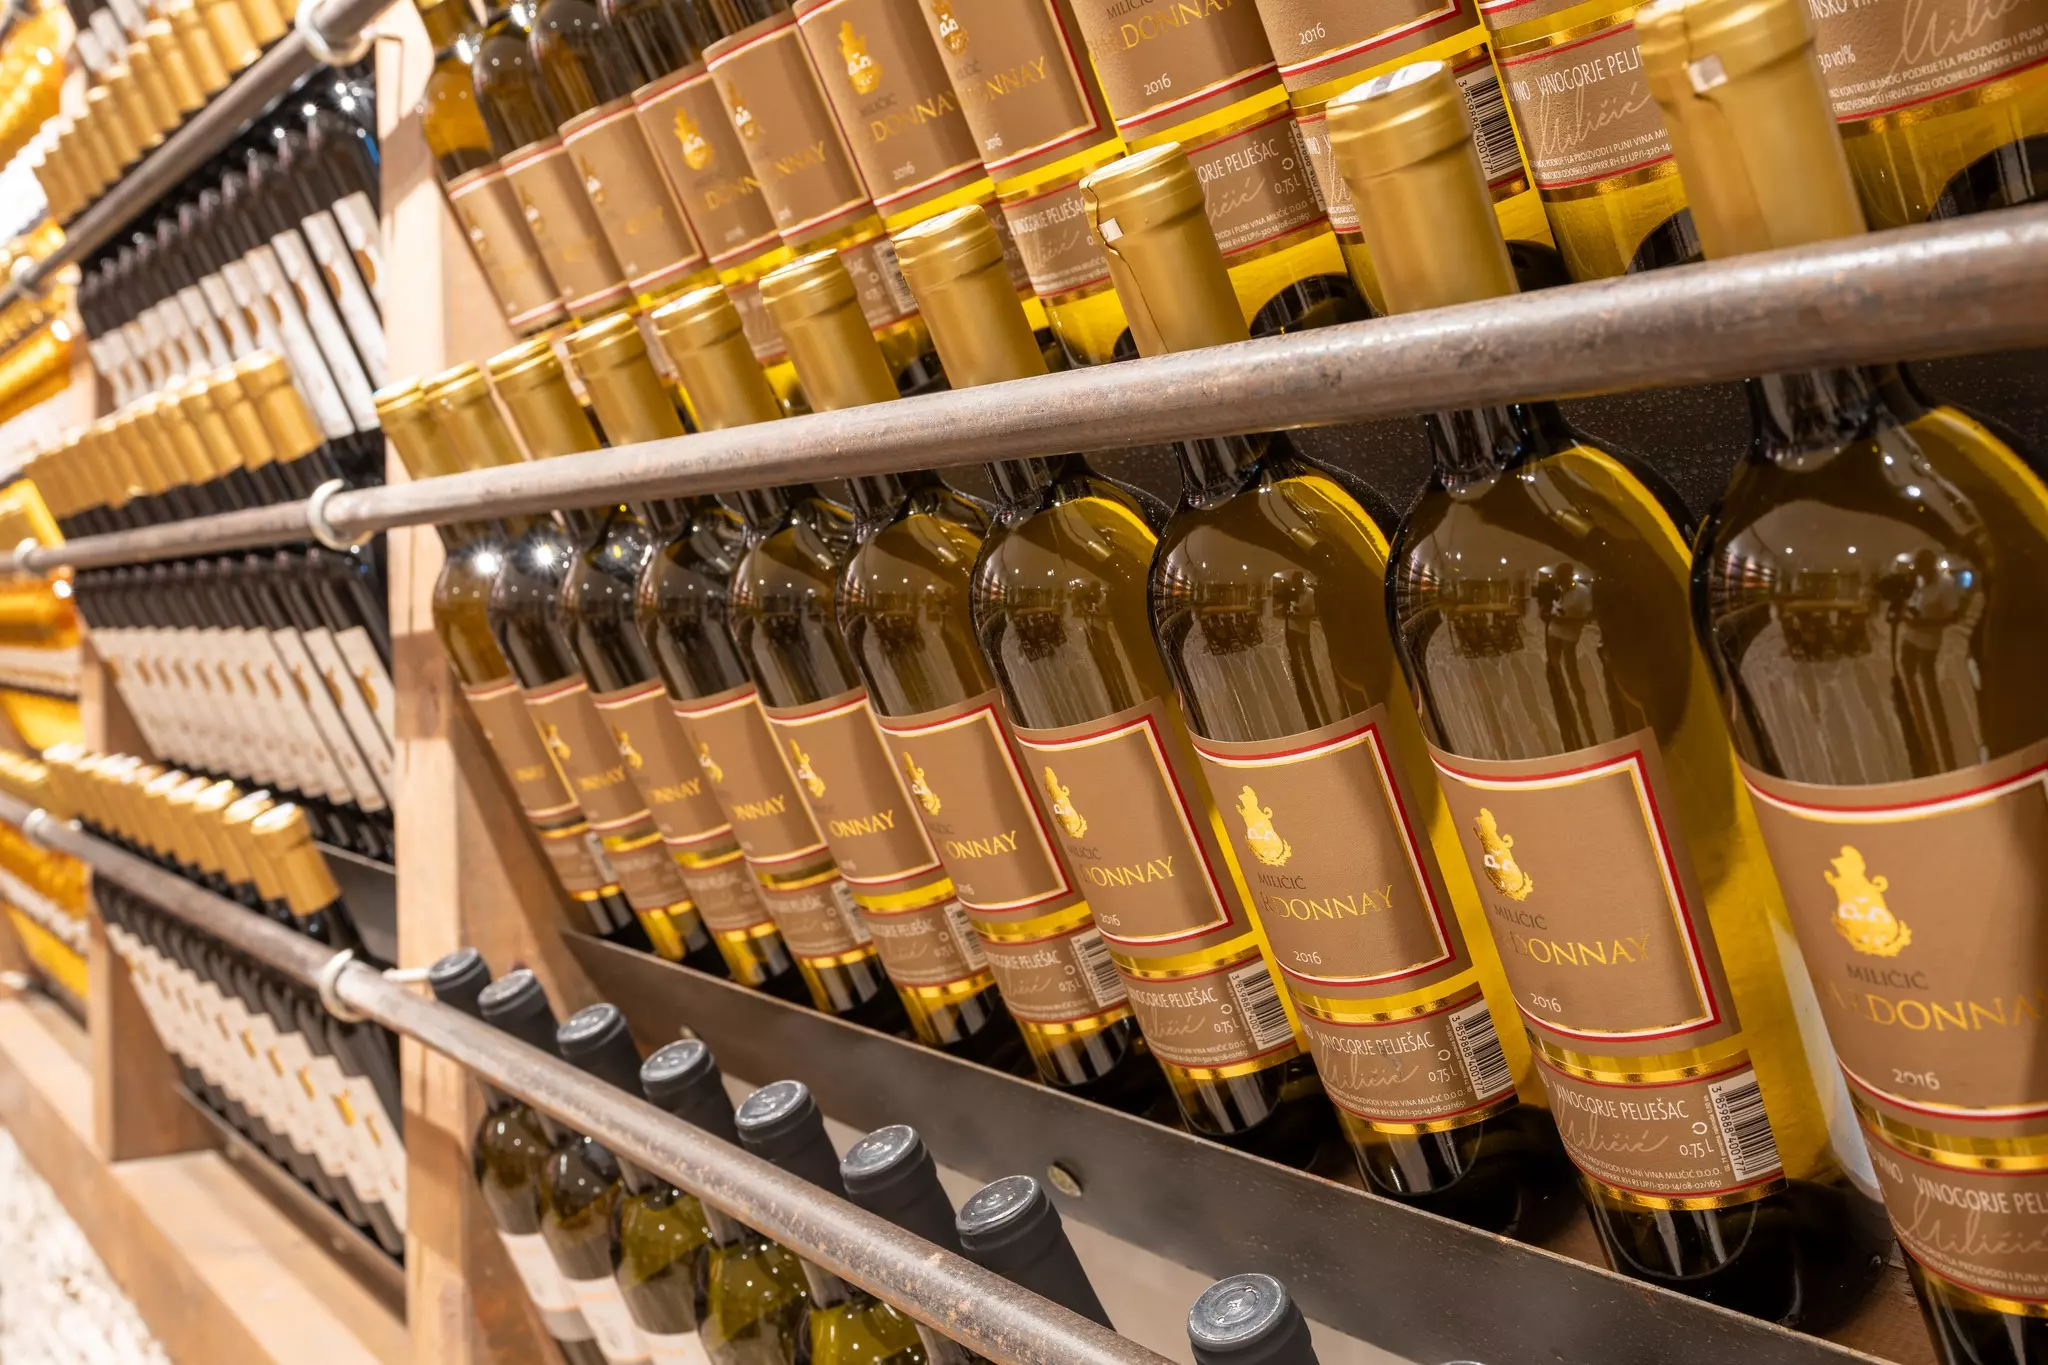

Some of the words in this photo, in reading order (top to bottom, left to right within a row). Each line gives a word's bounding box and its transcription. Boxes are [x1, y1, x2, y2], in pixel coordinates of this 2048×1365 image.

[1299, 22, 1326, 45] 2016
[1144, 73, 1172, 96] 2016
[1535, 58, 1606, 98] VINOGORJE
[1632, 134, 1654, 147] VINA
[1224, 138, 1280, 174] PELJEŠAC
[1274, 177, 1296, 195] 0.75
[1257, 871, 1307, 890] MILIČIĆ
[1099, 912, 1121, 927] 2016
[1493, 903, 1548, 931] MILIČIĆ
[1293, 950, 1323, 966] 2016
[1846, 962, 1930, 991] MILIČIĆ
[1168, 986, 1219, 1010] PELJEŠAC
[1530, 992, 1563, 1014] 2016
[1213, 1020, 1234, 1034] 0.75
[1316, 1030, 1376, 1056] VINOGORJE
[1375, 1030, 1436, 1056] PELJEŠAC
[1455, 1025, 1473, 1058] 859888
[1468, 1060, 1485, 1092] 400177
[1428, 1069, 1451, 1083] 0.75
[1449, 1064, 1458, 1076] L
[1892, 1067, 1941, 1091] 2016
[1400, 1099, 1418, 1108] VINA
[1417, 1093, 1443, 1106] MILIČIĆ
[1552, 1081, 1619, 1119] VINOGORJE
[1619, 1097, 1689, 1121] PELJEŠAC
[1715, 1097, 1735, 1134] 859888
[1728, 1137, 1747, 1172] 400177
[1679, 1142, 1705, 1159] 0.75
[1705, 1138, 1715, 1153] L
[1624, 1166, 1645, 1178] PUNI
[1645, 1169, 1665, 1179] VINA
[1664, 1168, 1696, 1180] MILIČIĆ
[1695, 1166, 1723, 1178] D.O.O.
[1912, 1173, 2012, 1214] VINOGORJE
